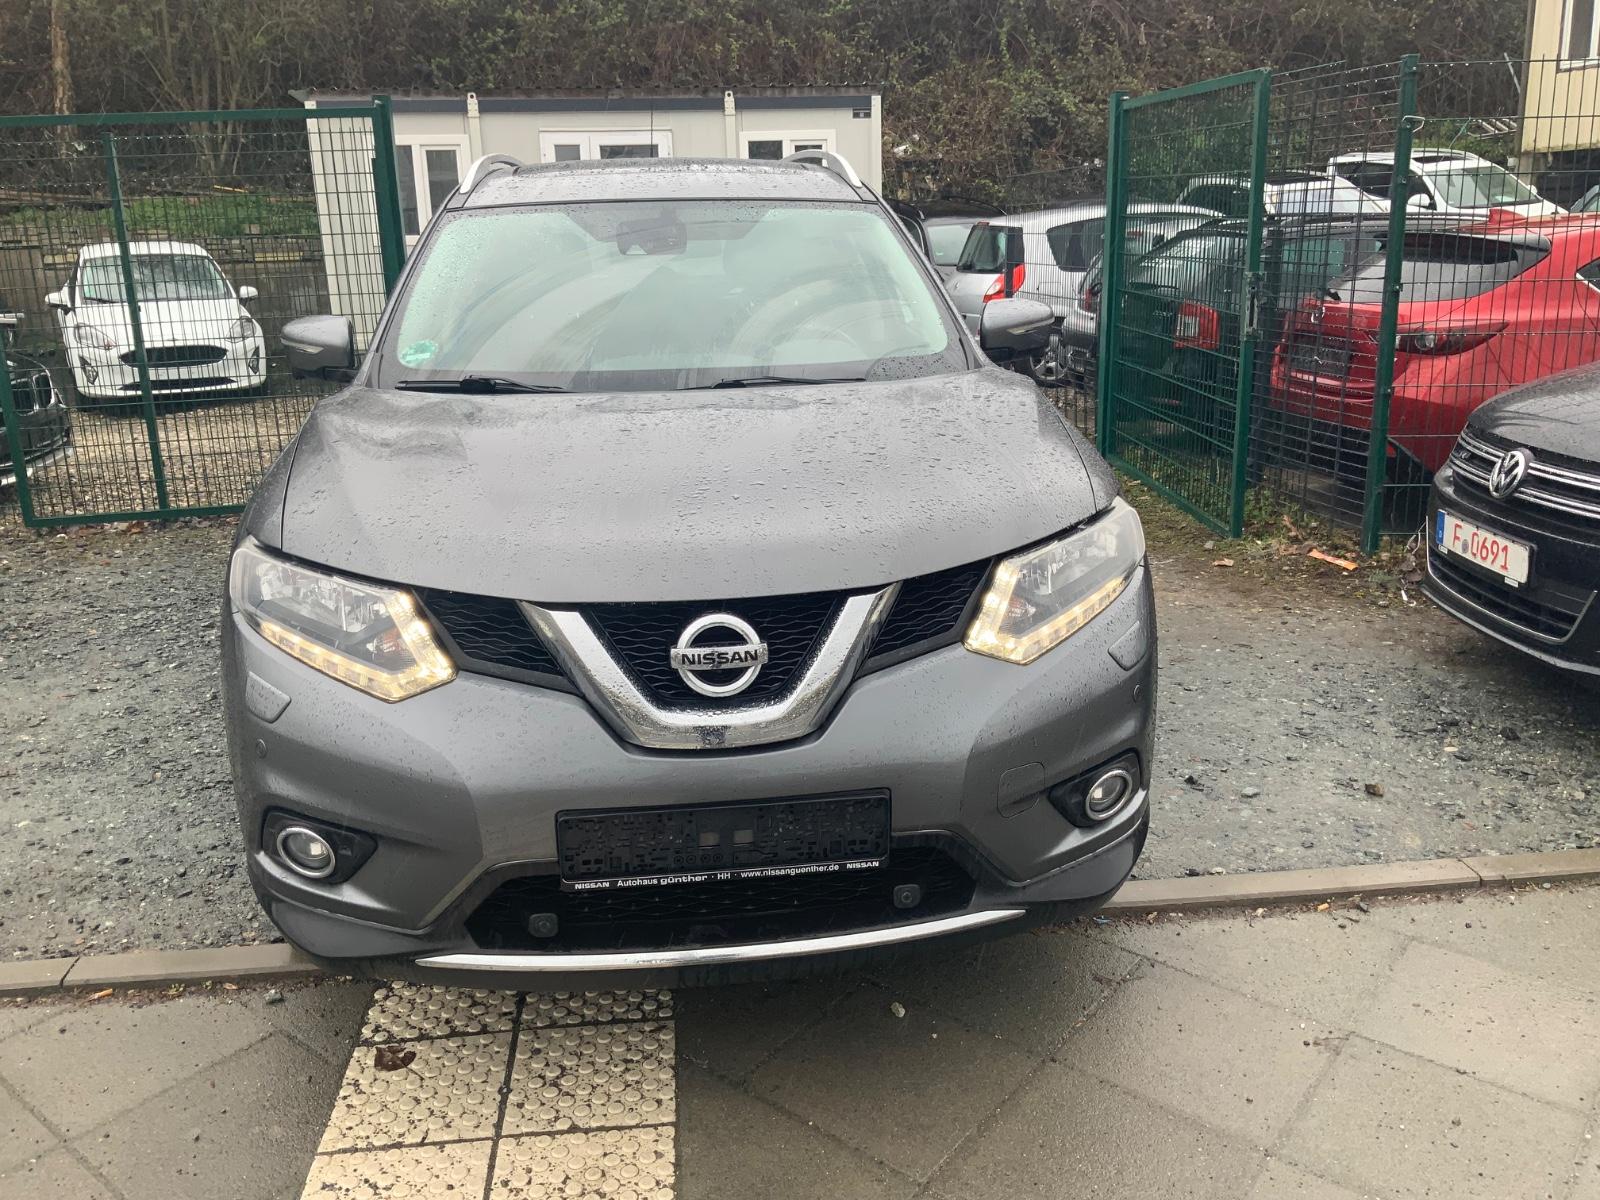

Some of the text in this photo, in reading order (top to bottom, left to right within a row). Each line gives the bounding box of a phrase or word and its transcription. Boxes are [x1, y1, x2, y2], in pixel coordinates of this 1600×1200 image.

[1453, 523, 1508, 571] F 0691
[681, 649, 759, 665] NISSAN
[574, 860, 880, 890] NISSAN Autohaus günther HH www.nissanguenther.de NISSAN
